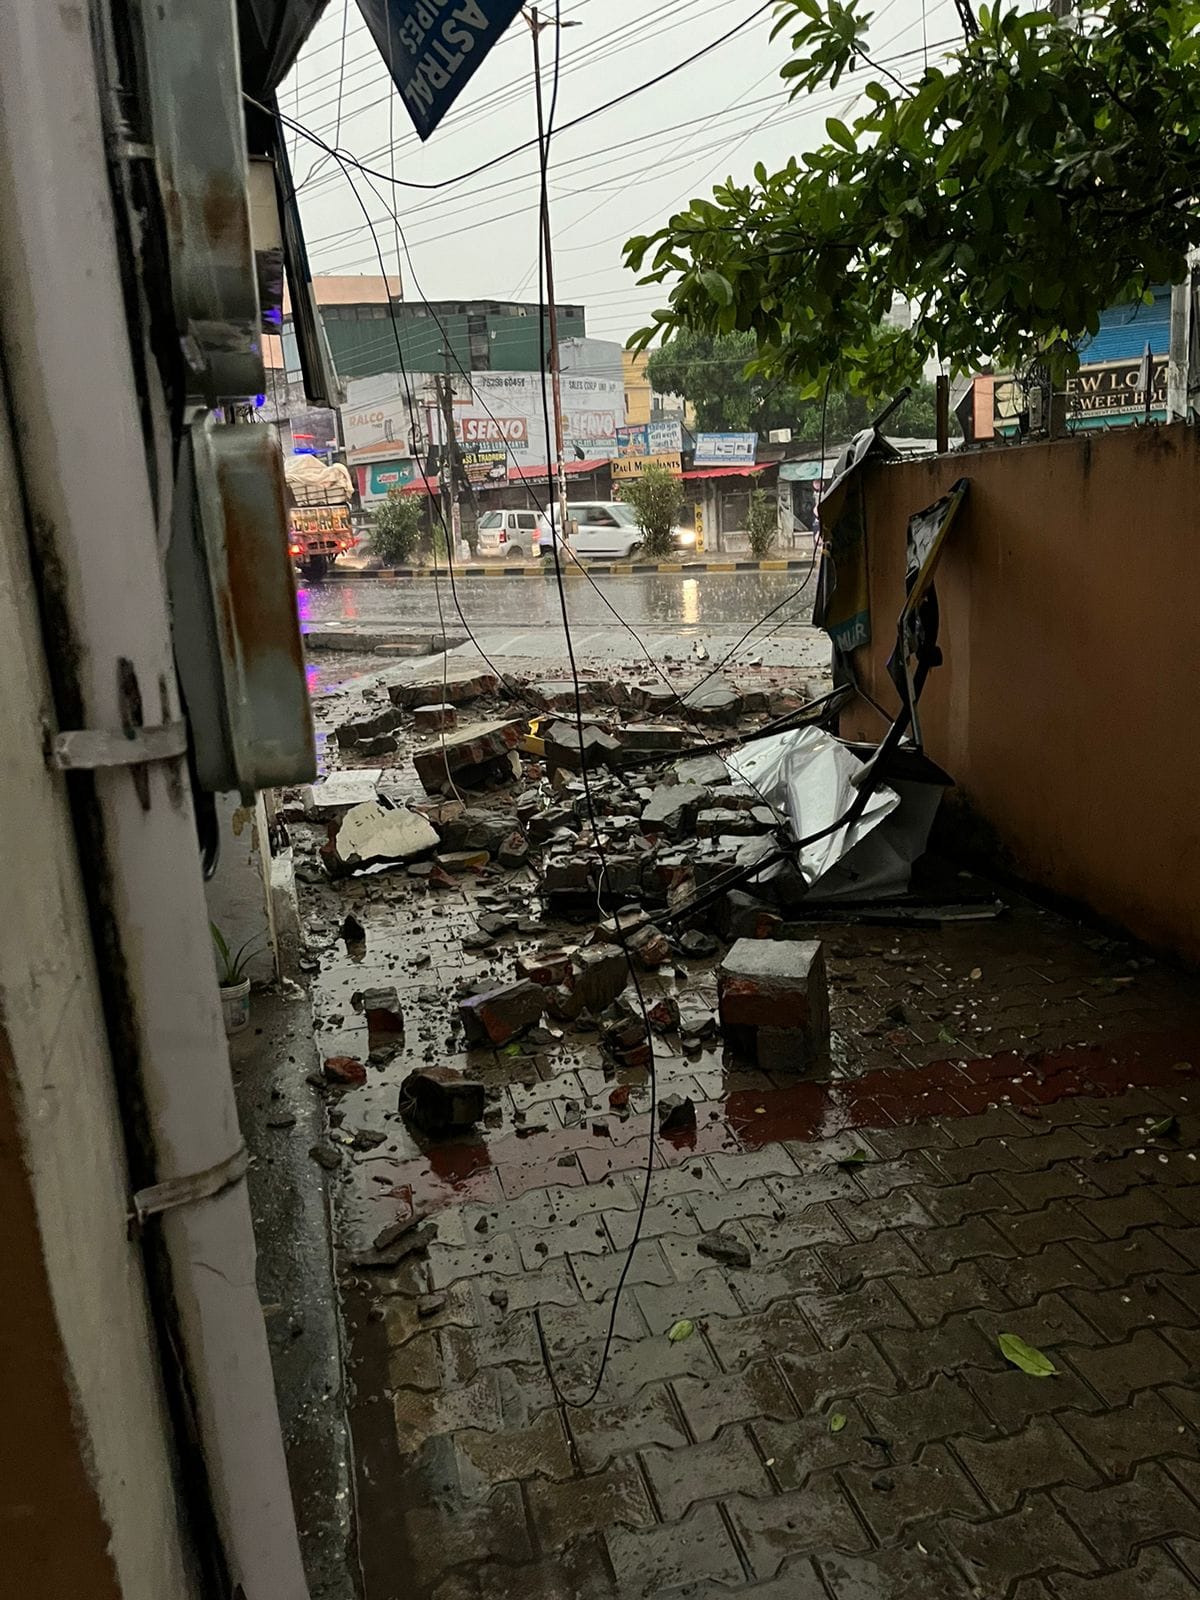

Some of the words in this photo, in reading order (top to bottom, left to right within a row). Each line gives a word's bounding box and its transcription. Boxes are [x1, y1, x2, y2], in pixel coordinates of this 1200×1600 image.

[399, 0, 454, 54] IPES
[404, 0, 490, 116] ASTRAL
[1065, 372, 1104, 393] EW
[349, 411, 384, 427] RALCO
[467, 418, 525, 442] SERVO
[635, 459, 680, 472] MHANTS
